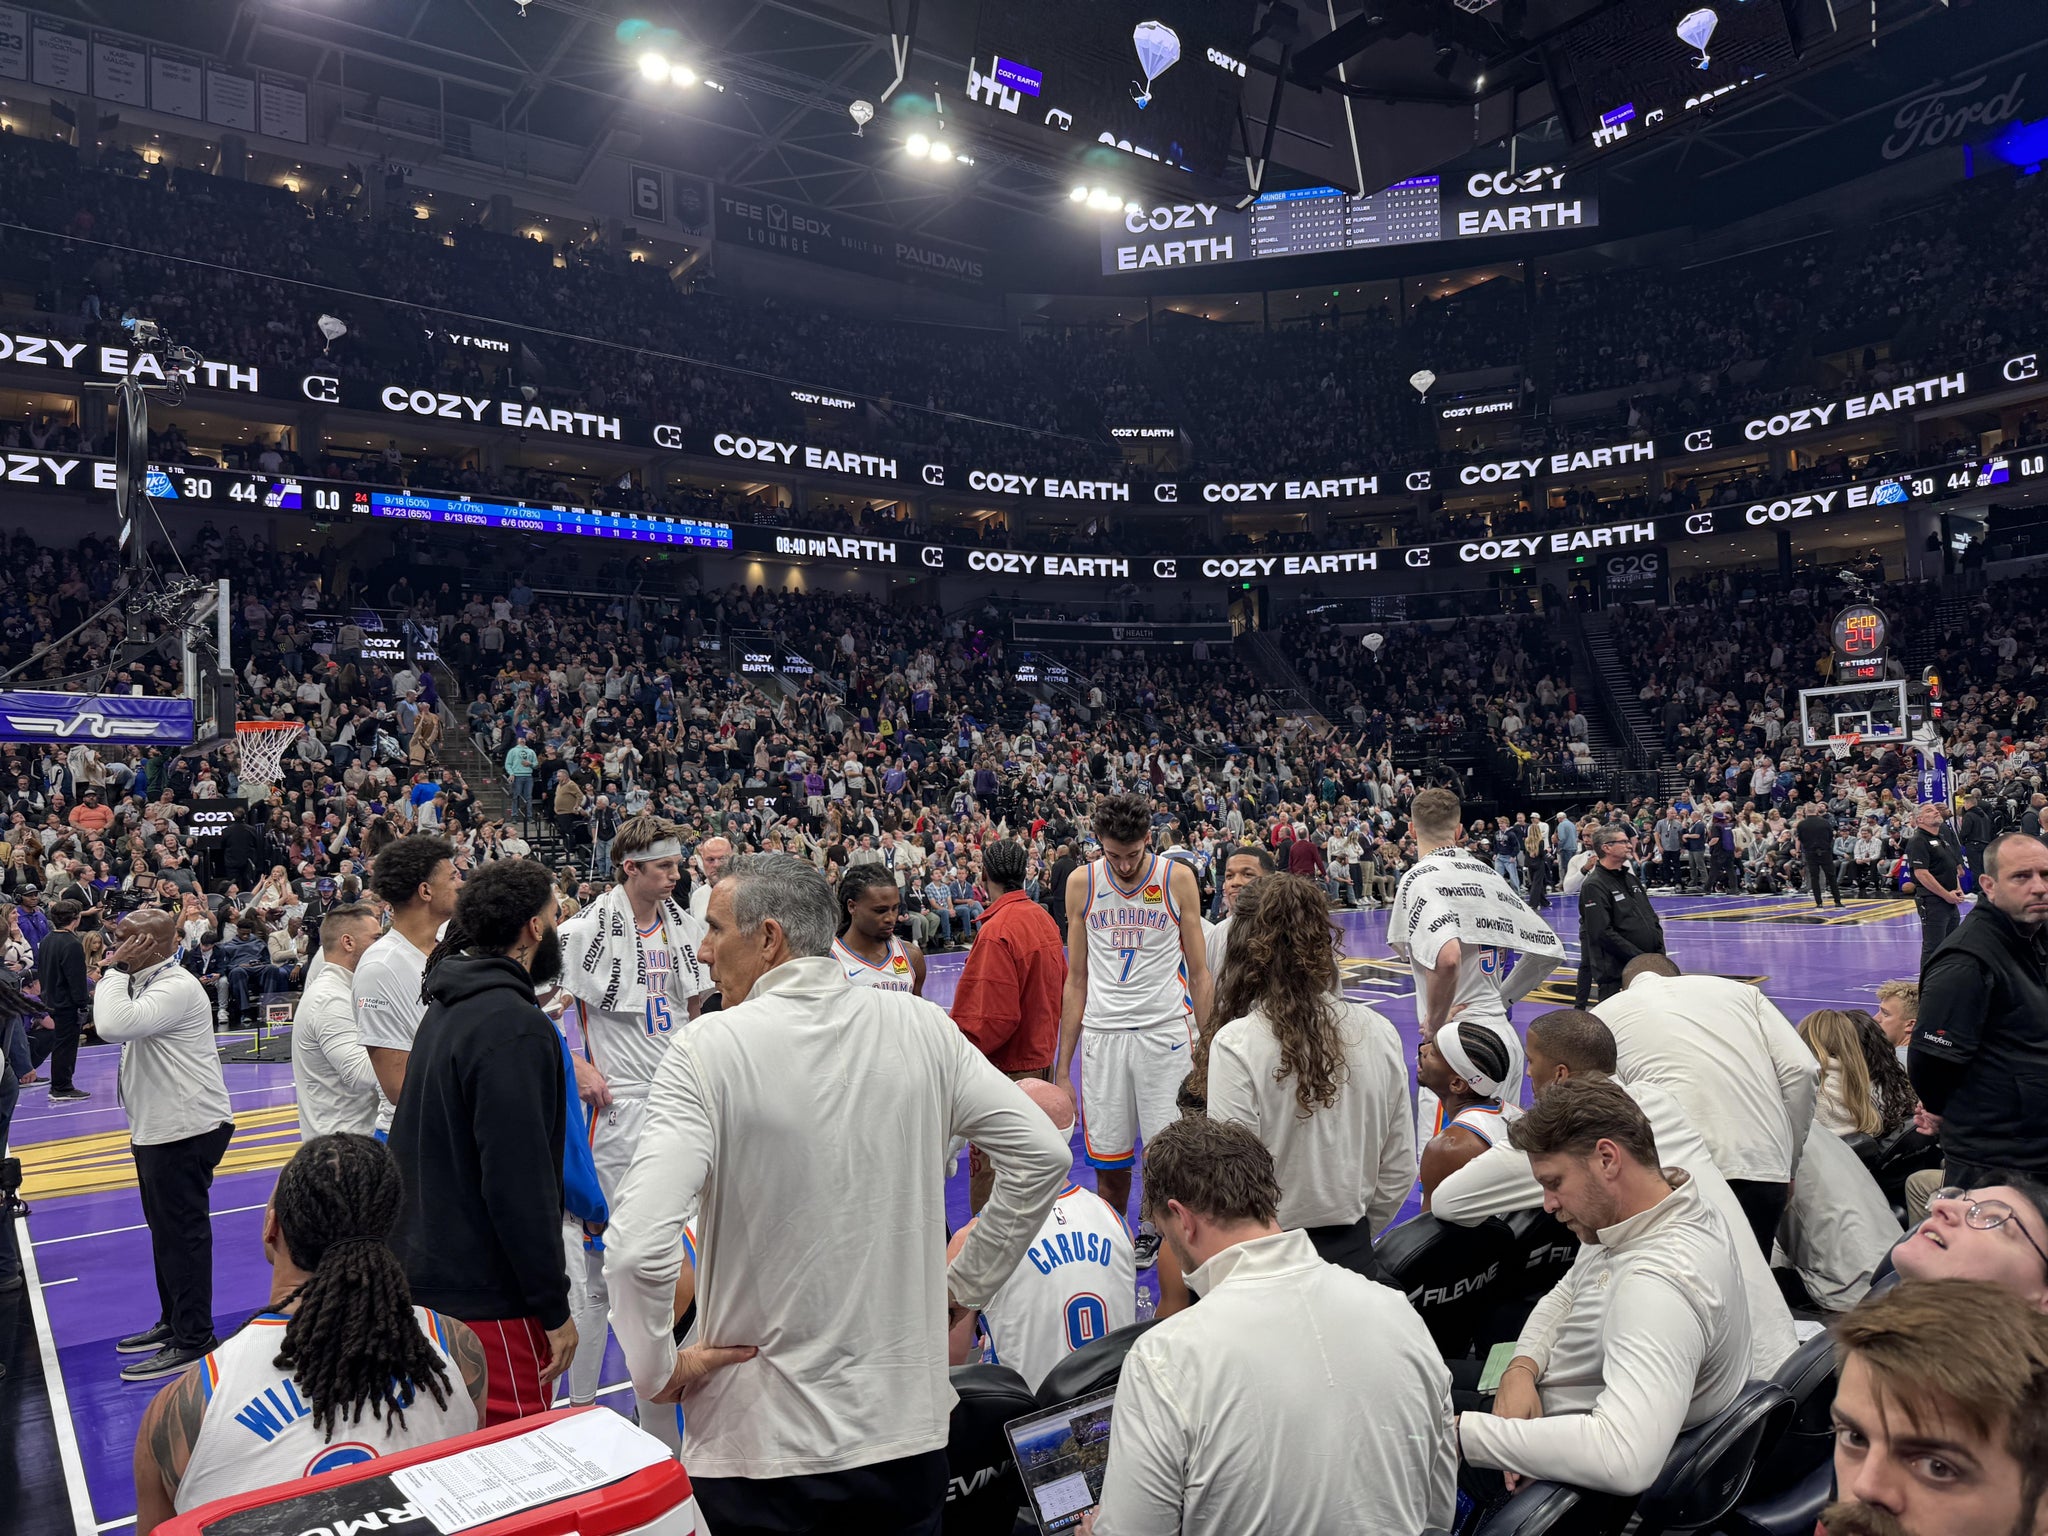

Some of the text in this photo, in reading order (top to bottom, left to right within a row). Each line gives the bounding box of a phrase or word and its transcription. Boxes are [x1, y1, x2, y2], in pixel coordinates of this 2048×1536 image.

[39, 40, 82, 56] STOCKTON
[109, 50, 128, 61] KARL
[103, 55, 136, 69] MALONE
[1207, 48, 1238, 73] COZY
[998, 68, 1040, 88] COZY EARTH
[1881, 72, 2026, 161] Ford
[1467, 165, 1566, 197] COZY
[637, 177, 659, 210] 6
[721, 197, 832, 238] TEE BOX
[1125, 203, 1218, 233] COZY
[1458, 201, 1581, 235] EARTH
[747, 227, 809, 254] LOUNGE
[841, 237, 868, 254] BUILT
[895, 243, 983, 278] PAUDAVIS
[1117, 236, 1232, 270] EARTH
[790, 391, 855, 410] COZY EARTH
[1442, 401, 1513, 419] COZY EARTH
[1744, 372, 1966, 441] COZY EARTH
[381, 386, 621, 441] COZY EARTH
[1111, 428, 1174, 438] COZY EARTH
[713, 433, 897, 479] COZY EARTH
[1460, 440, 1654, 487] COZY EARTH
[2020, 456, 2044, 476] 0.0
[183, 478, 212, 499] 30
[968, 470, 1129, 502] COZY EARTH
[1203, 475, 1378, 503] COZY EARTH
[1911, 478, 1934, 497] 30
[1947, 471, 1970, 489] 44
[229, 482, 258, 503] 44
[315, 490, 340, 511] 0.0
[354, 493, 368, 503] 24
[384, 496, 430, 508] 9/18 (50%)
[351, 503, 370, 514] 2ND
[382, 507, 432, 520] 15/23 (65%)
[448, 502, 484, 514] 5/7 (71%)
[504, 507, 541, 519] 7/9 (78%)
[1745, 489, 1838, 526] COZY
[444, 513, 487, 525] 8/13 (62%)
[501, 518, 544, 531] 6/6 (100%)
[594, 527, 601, 535] 11
[683, 536, 694, 544] 20
[700, 528, 711, 536] 125
[717, 530, 728, 538] 172
[700, 538, 711, 546] 172
[717, 539, 728, 547] 125
[776, 536, 827, 557] 08:40 PM
[1459, 522, 1655, 563] COZY EARTH
[968, 550, 1129, 578] COZY EARTH
[1202, 552, 1377, 578] COZY EARTH
[1607, 553, 1659, 575] G2G
[1846, 615, 1876, 629] 12:00
[364, 638, 401, 648] COZY
[1125, 629, 1154, 637] HEALTH
[1845, 628, 1875, 652] 24
[361, 650, 405, 660] EARTH
[744, 653, 771, 662] COZY
[1851, 657, 1883, 667] TISSOT
[742, 664, 774, 672] EARTH
[1924, 772, 1933, 798] FIRST
[747, 797, 777, 807] CZY
[189, 825, 228, 837] EAR
[1436, 885, 1486, 898] BODYARMOR
[1090, 908, 1169, 931] OKLAHOMA
[1111, 928, 1145, 949] CITY
[1117, 948, 1137, 983] 7
[645, 996, 673, 1036] 15
[1924, 1031, 1953, 1048] Interform
[1027, 1231, 1112, 1276] CARUSO
[1423, 1261, 1499, 1307] FILEVINE
